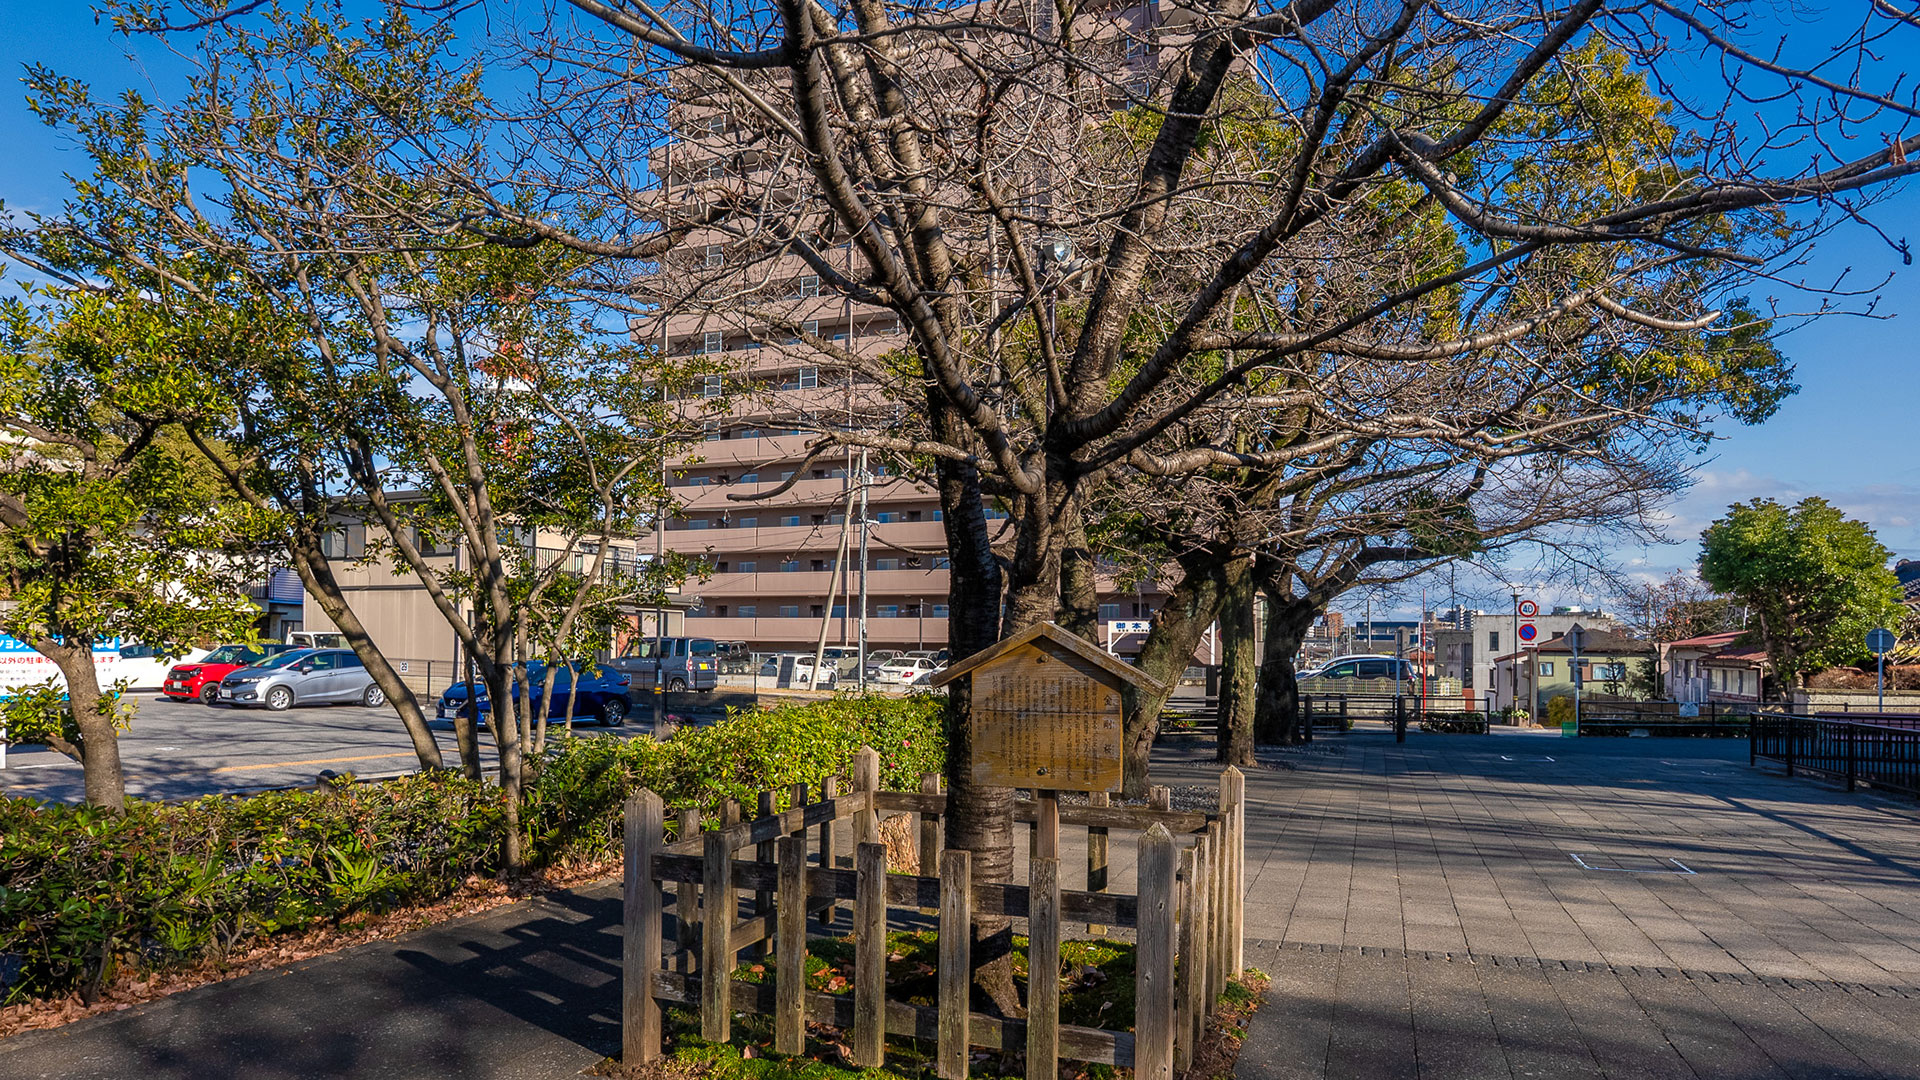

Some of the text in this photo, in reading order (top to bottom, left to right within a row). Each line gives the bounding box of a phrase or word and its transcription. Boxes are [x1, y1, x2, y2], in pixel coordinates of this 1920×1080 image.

[1522, 604, 1533, 613] 40
[1116, 622, 1152, 631] 御本
[0, 656, 56, 665] 以外の駐車を
